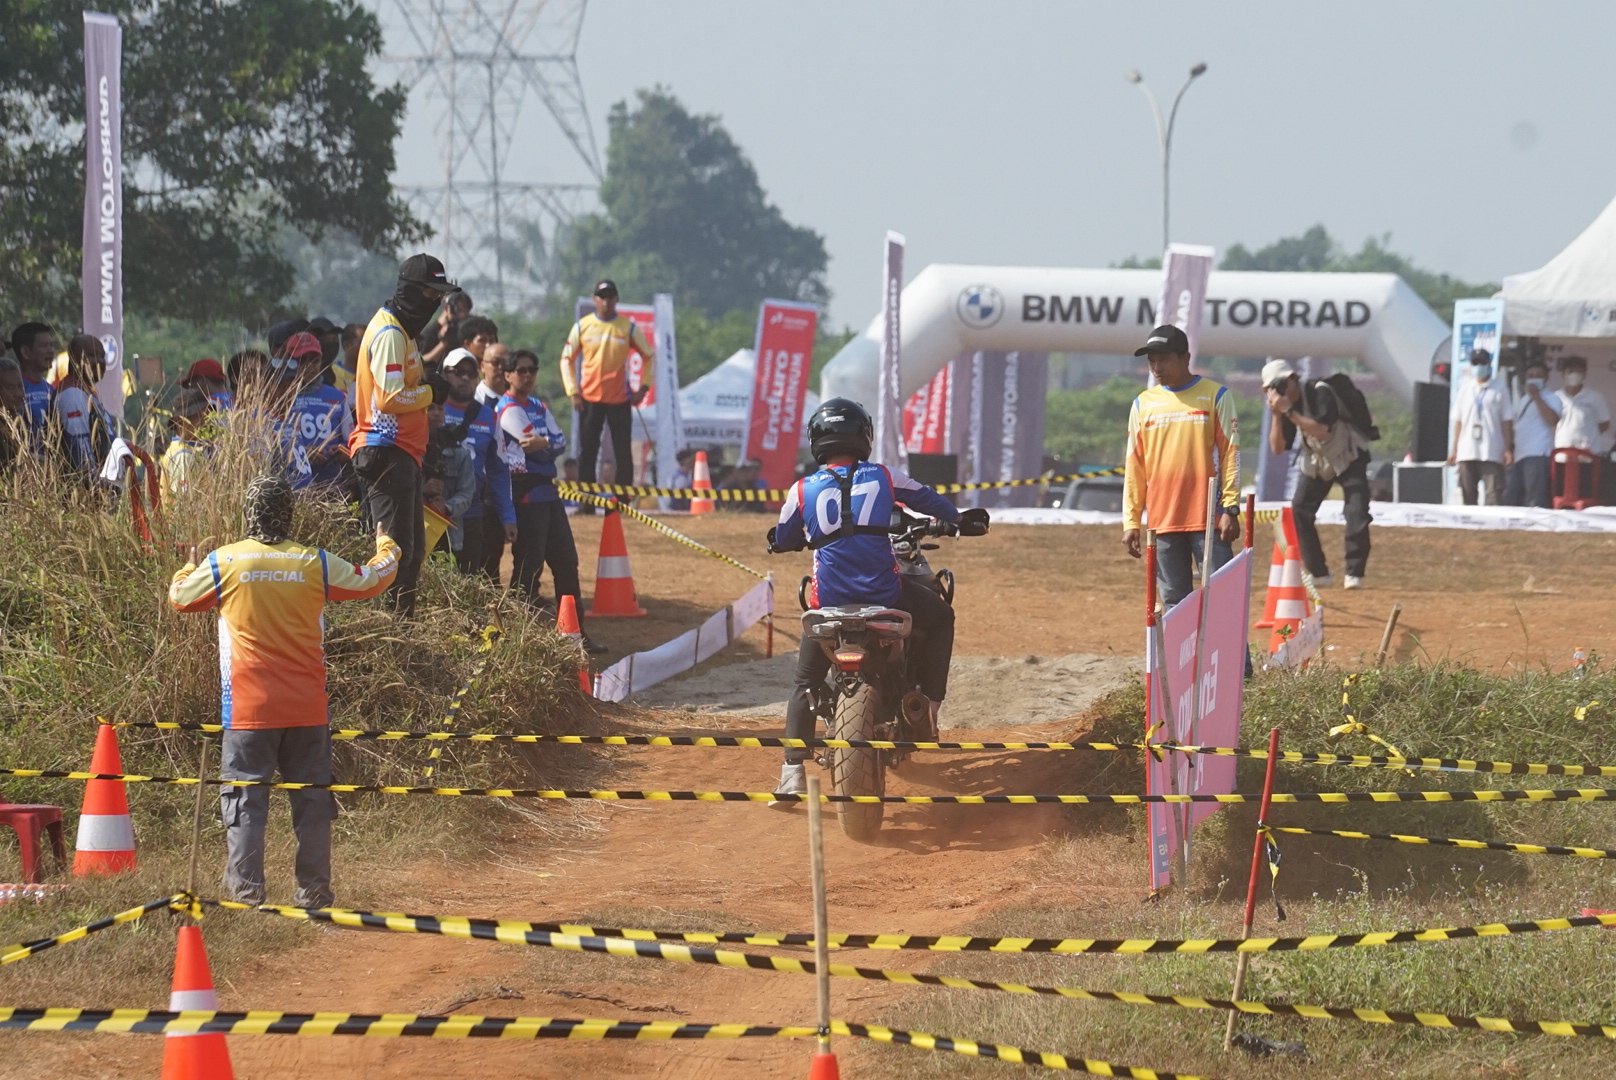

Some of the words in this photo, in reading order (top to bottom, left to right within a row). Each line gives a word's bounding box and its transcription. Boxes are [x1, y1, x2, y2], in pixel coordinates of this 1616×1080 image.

[1021, 294, 1123, 324] BMW
[1137, 298, 1371, 328] MTORRAD
[762, 350, 789, 451] Enduro
[781, 353, 804, 433] PLATINUM
[1002, 350, 1019, 445] MOTORRA
[300, 412, 333, 440] 69
[816, 480, 881, 536] 07
[239, 570, 306, 583] OFFICIAL
